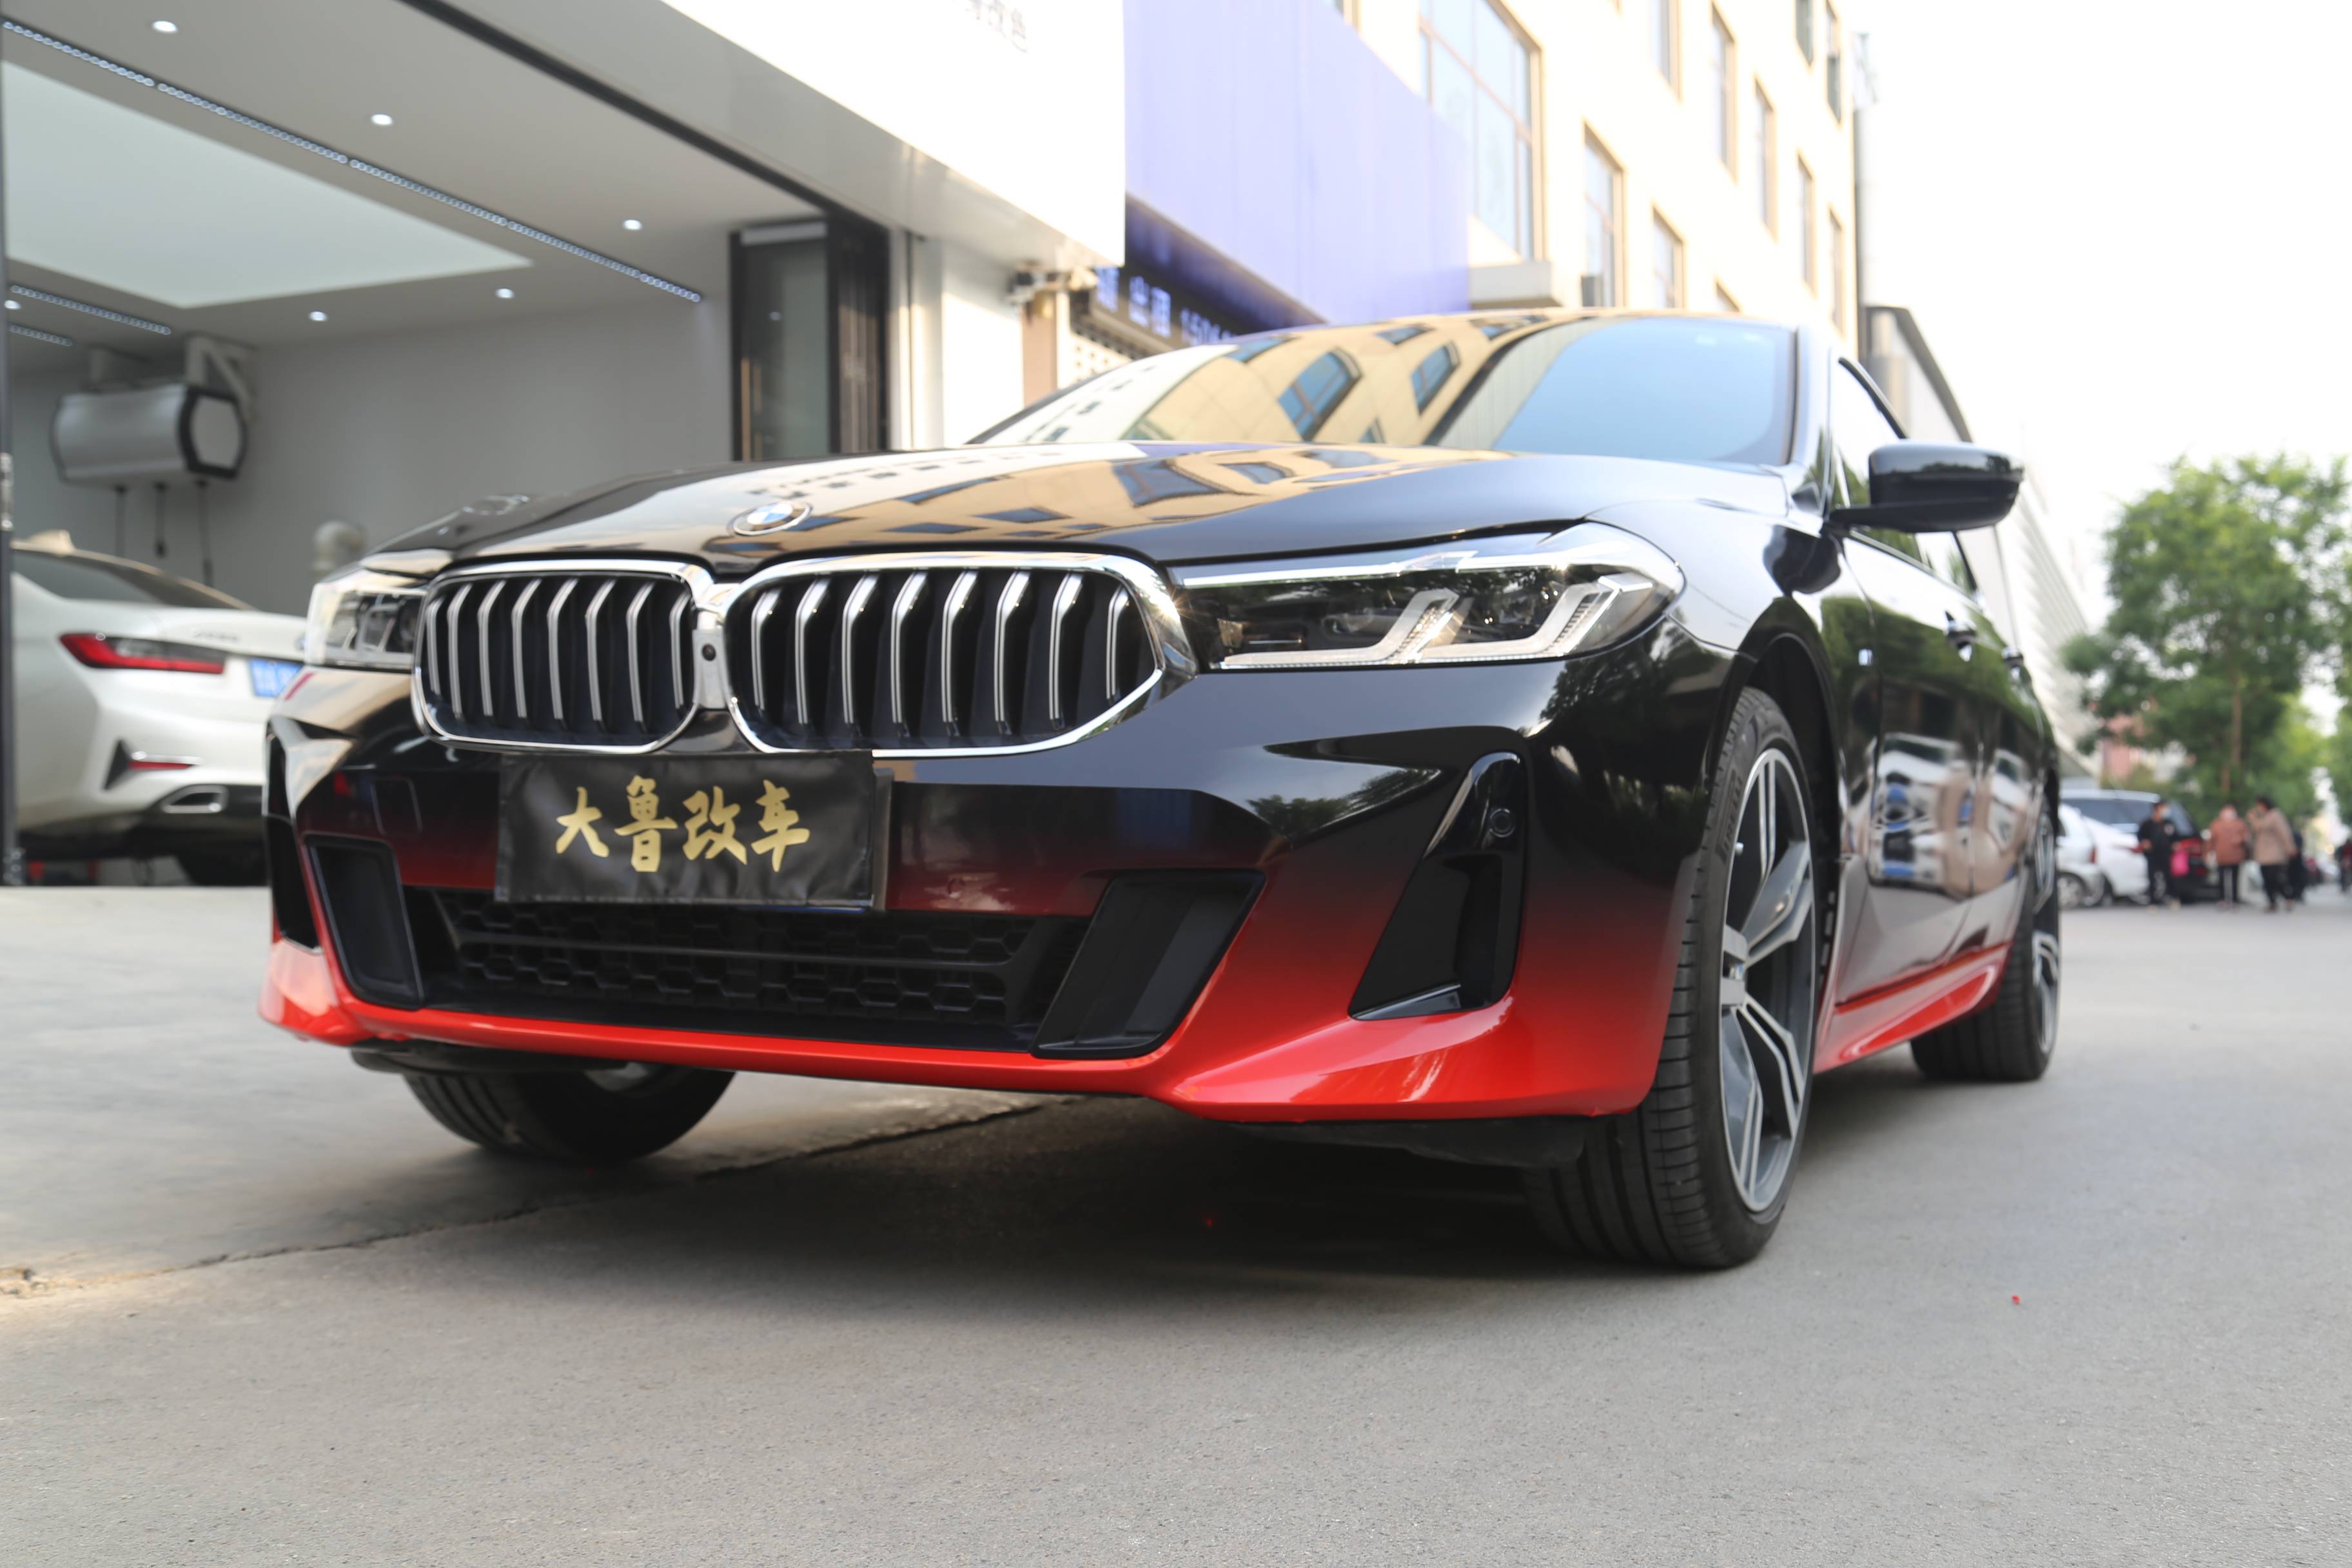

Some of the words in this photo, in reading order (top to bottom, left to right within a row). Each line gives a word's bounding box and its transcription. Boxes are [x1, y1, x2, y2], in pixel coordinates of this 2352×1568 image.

[556, 775, 811, 872] 大鲁改车
[1714, 769, 1743, 865] PIRELLI
